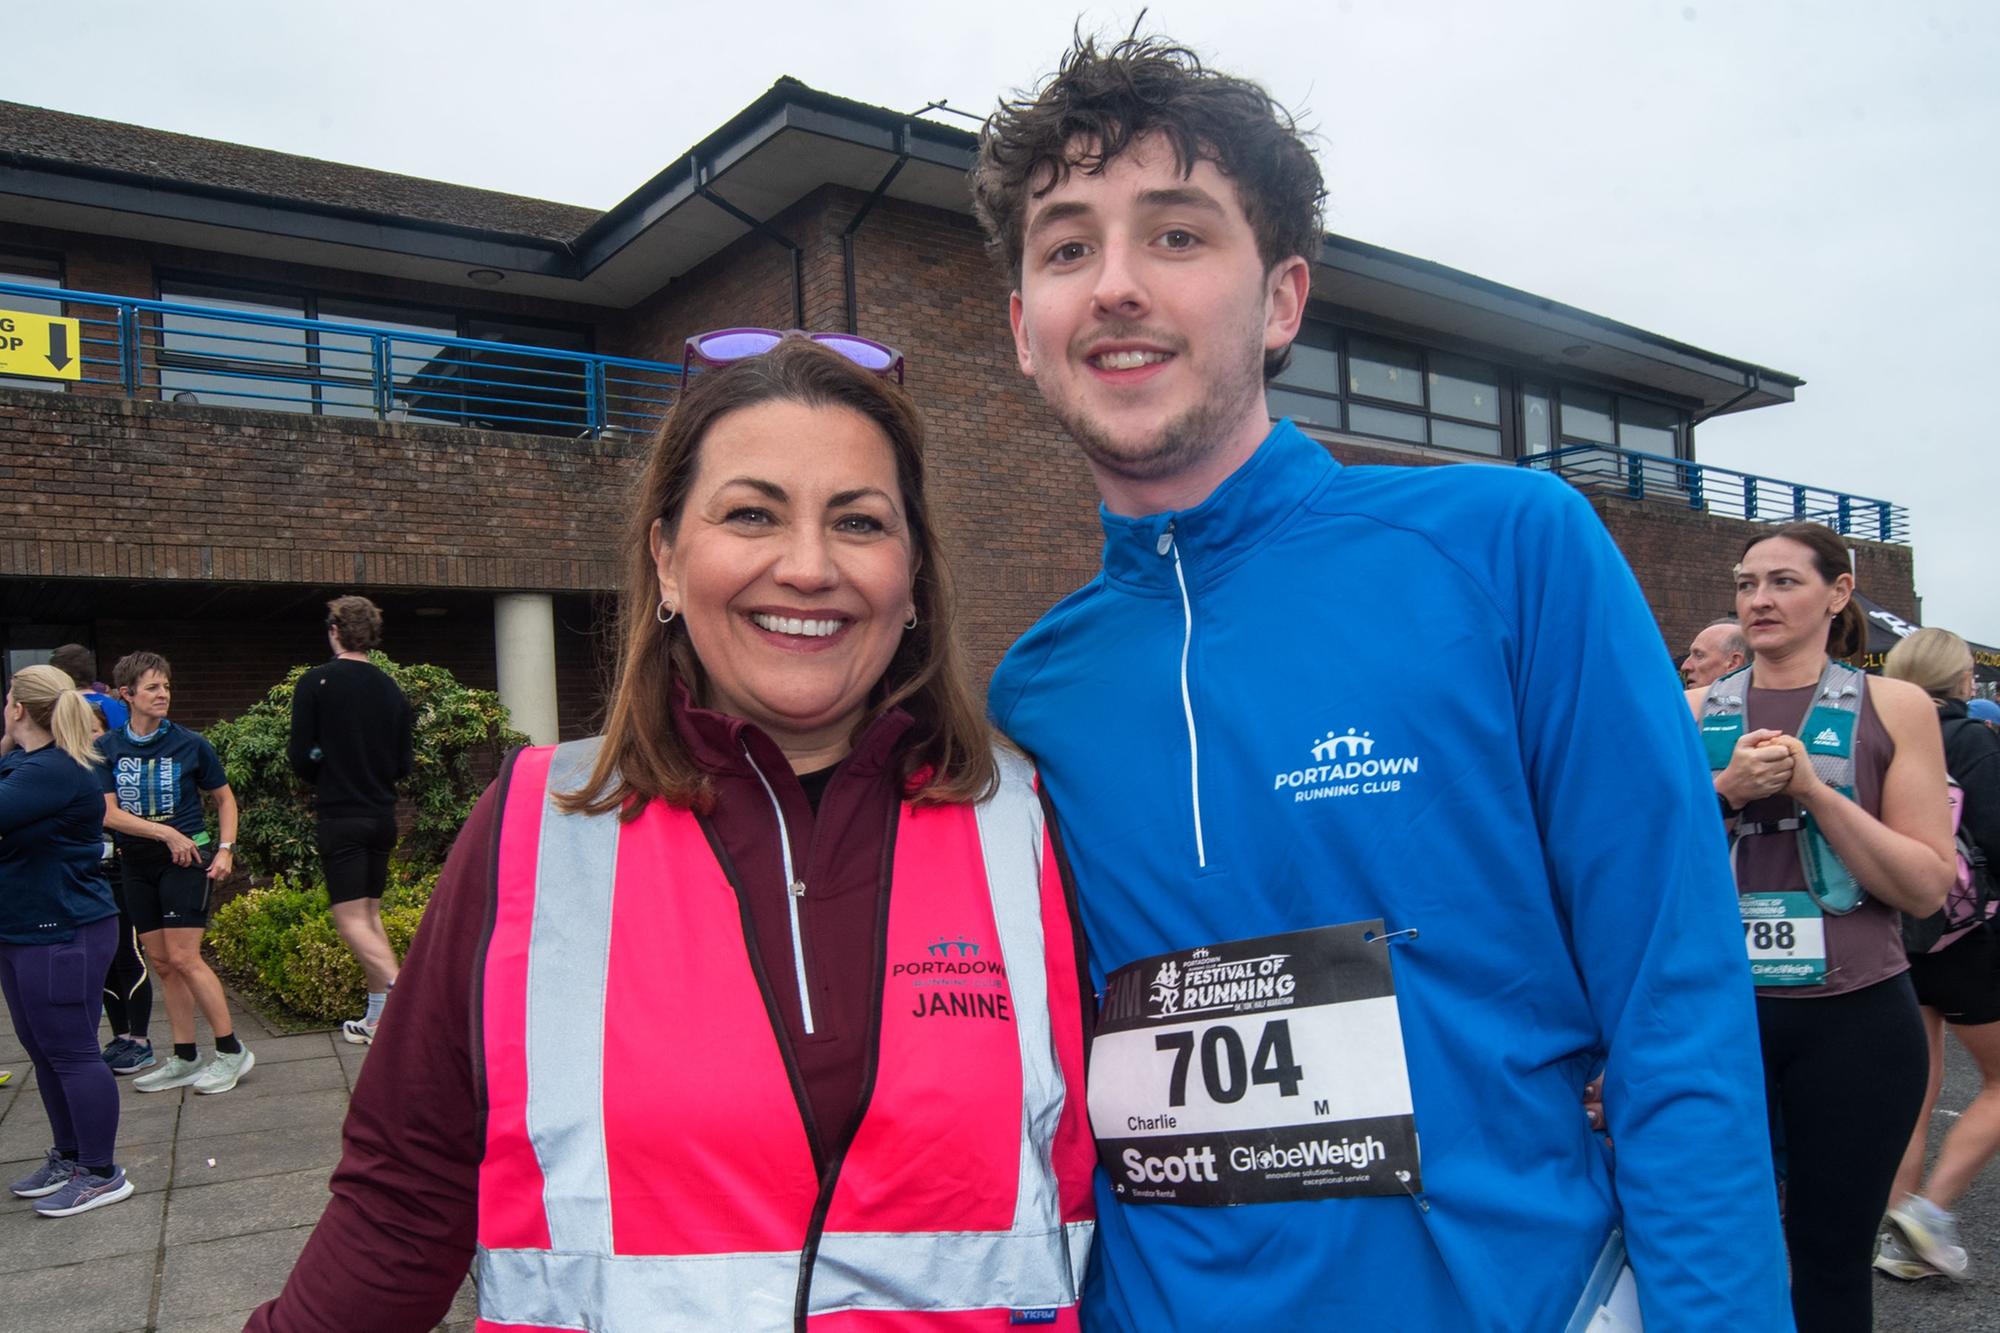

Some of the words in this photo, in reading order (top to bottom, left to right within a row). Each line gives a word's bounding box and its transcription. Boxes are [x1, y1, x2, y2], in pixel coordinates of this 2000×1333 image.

[116, 757, 142, 815] 2022
[160, 757, 173, 792] NEWRY
[1274, 757, 1419, 790] PORTADOWN
[161, 793, 174, 814] CITY
[1294, 784, 1359, 803] RUNNING
[1362, 780, 1401, 794] CLUB
[1184, 965, 1256, 987] FESTIVAL
[1258, 958, 1285, 975] OF
[912, 992, 1010, 1021] JANINE
[1183, 974, 1296, 1009] RUNNING
[1155, 1018, 1304, 1107] 704
[1127, 1114, 1177, 1131] Charlie
[1314, 1100, 1330, 1116] M
[1122, 1146, 1218, 1183] Scott
[1230, 1136, 1385, 1171] GlobeWeigh
[1302, 1176, 1344, 1186] exceptional
[1344, 1174, 1371, 1183] service
